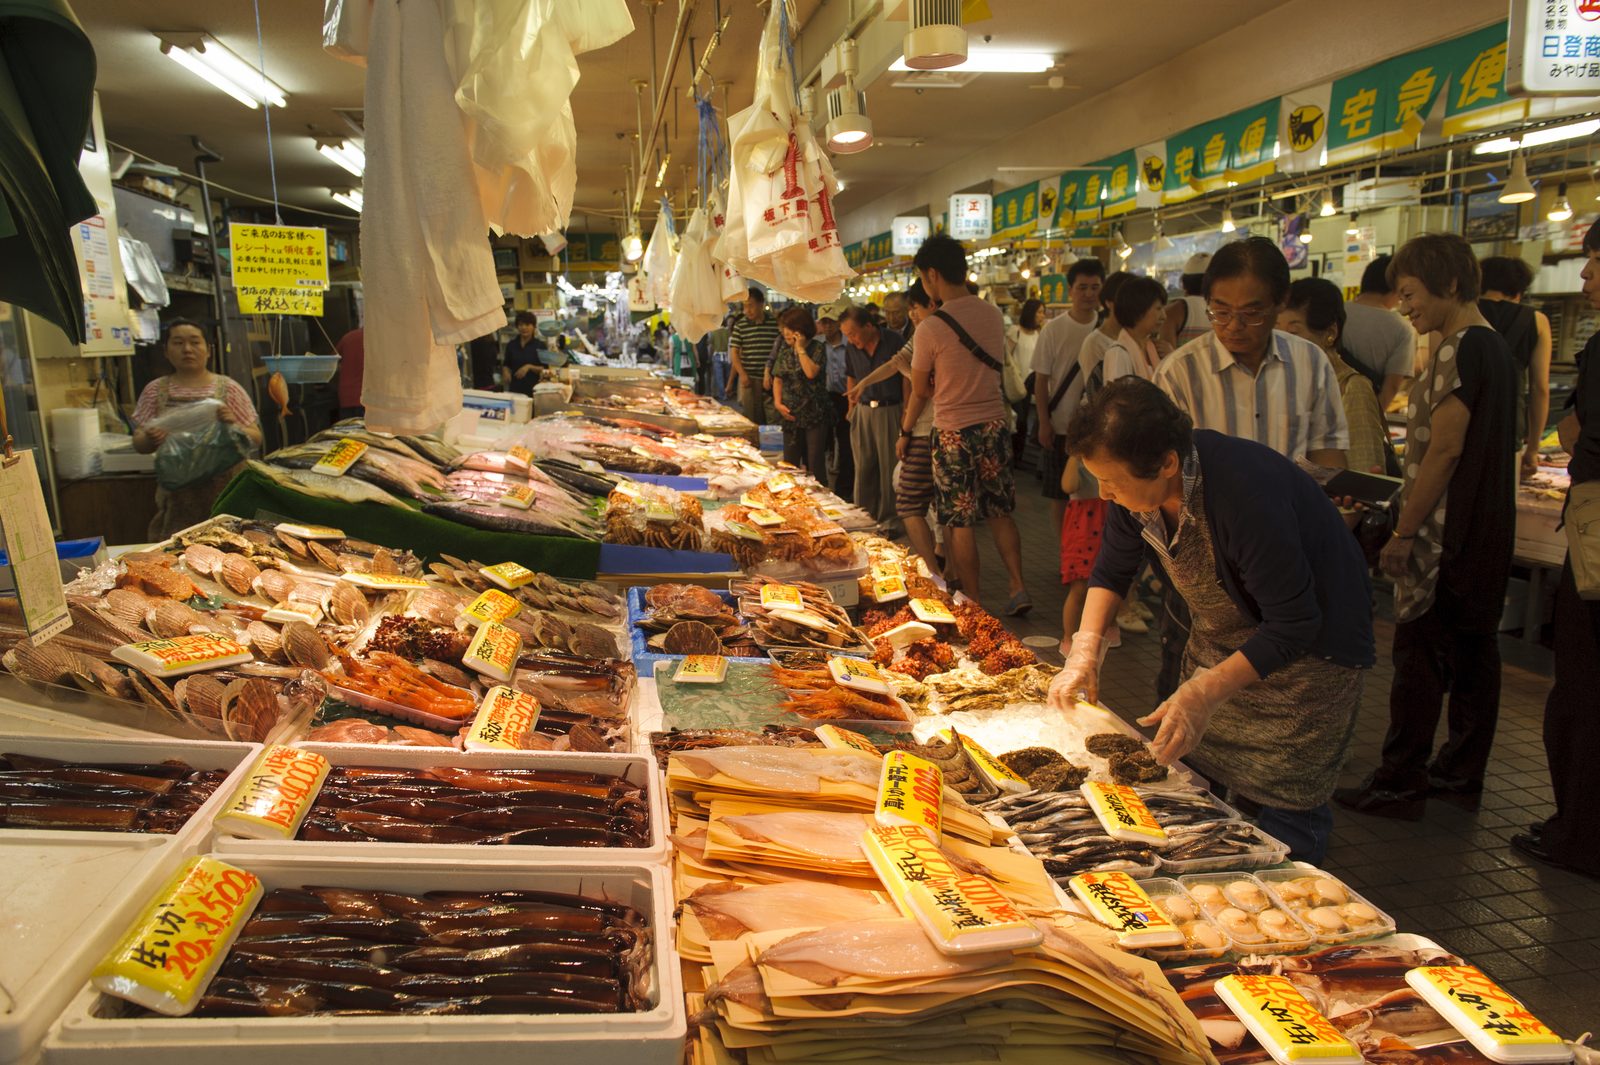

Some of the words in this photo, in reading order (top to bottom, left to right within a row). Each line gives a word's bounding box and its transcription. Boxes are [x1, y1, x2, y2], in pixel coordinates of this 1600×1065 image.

[1340, 41, 1507, 140] 宅急便
[1174, 116, 1267, 184] 宅急便
[241, 228, 316, 240] ご来店のお客様へ
[1447, 987, 1522, 1037] 生いか
